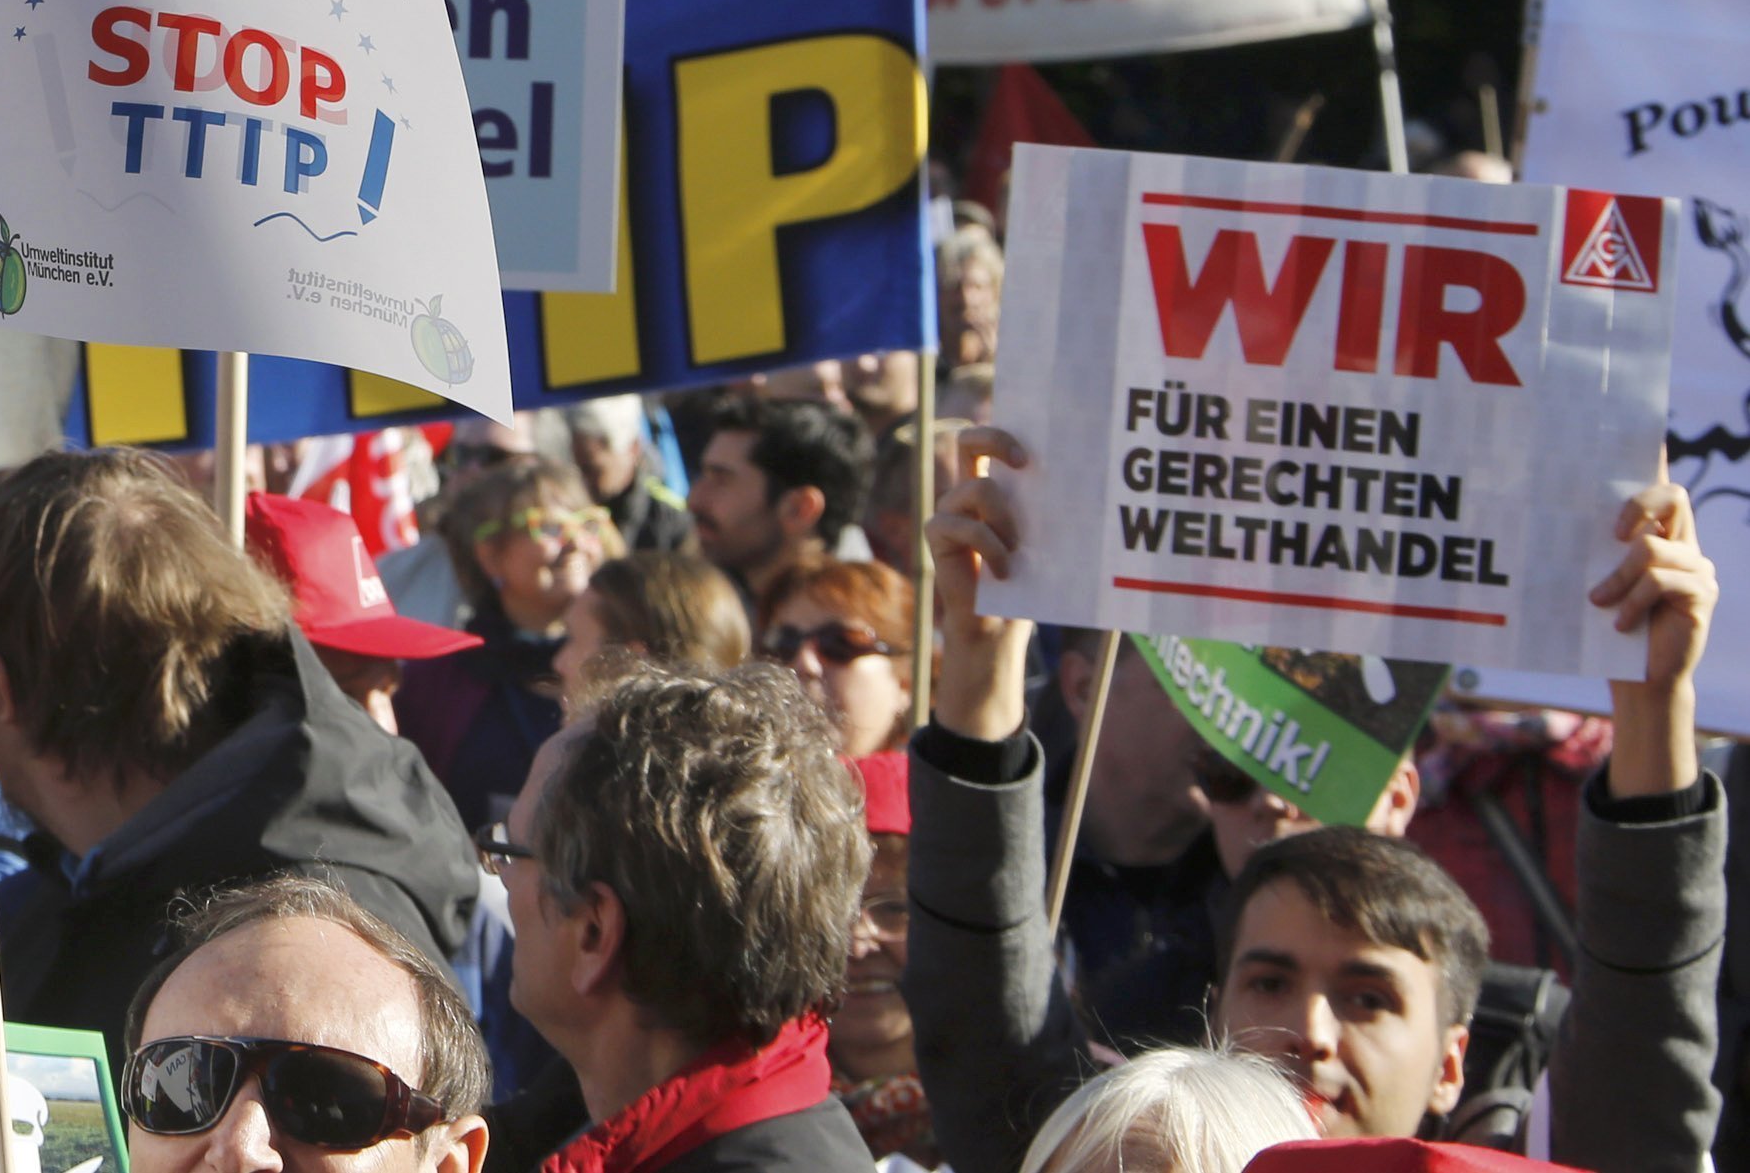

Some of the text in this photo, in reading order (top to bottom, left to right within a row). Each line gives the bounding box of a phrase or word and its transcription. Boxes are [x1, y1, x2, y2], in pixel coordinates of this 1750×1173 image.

[88, 6, 346, 120] STOP
[21, 242, 114, 270] Umweltinstitut
[27, 261, 114, 288] München e.V.
[1142, 222, 1527, 387] WIR
[1126, 380, 1420, 458] FÜR EINEN
[1122, 448, 1462, 521] GERECHTEN
[1119, 506, 1510, 587] WELTHANDEL
